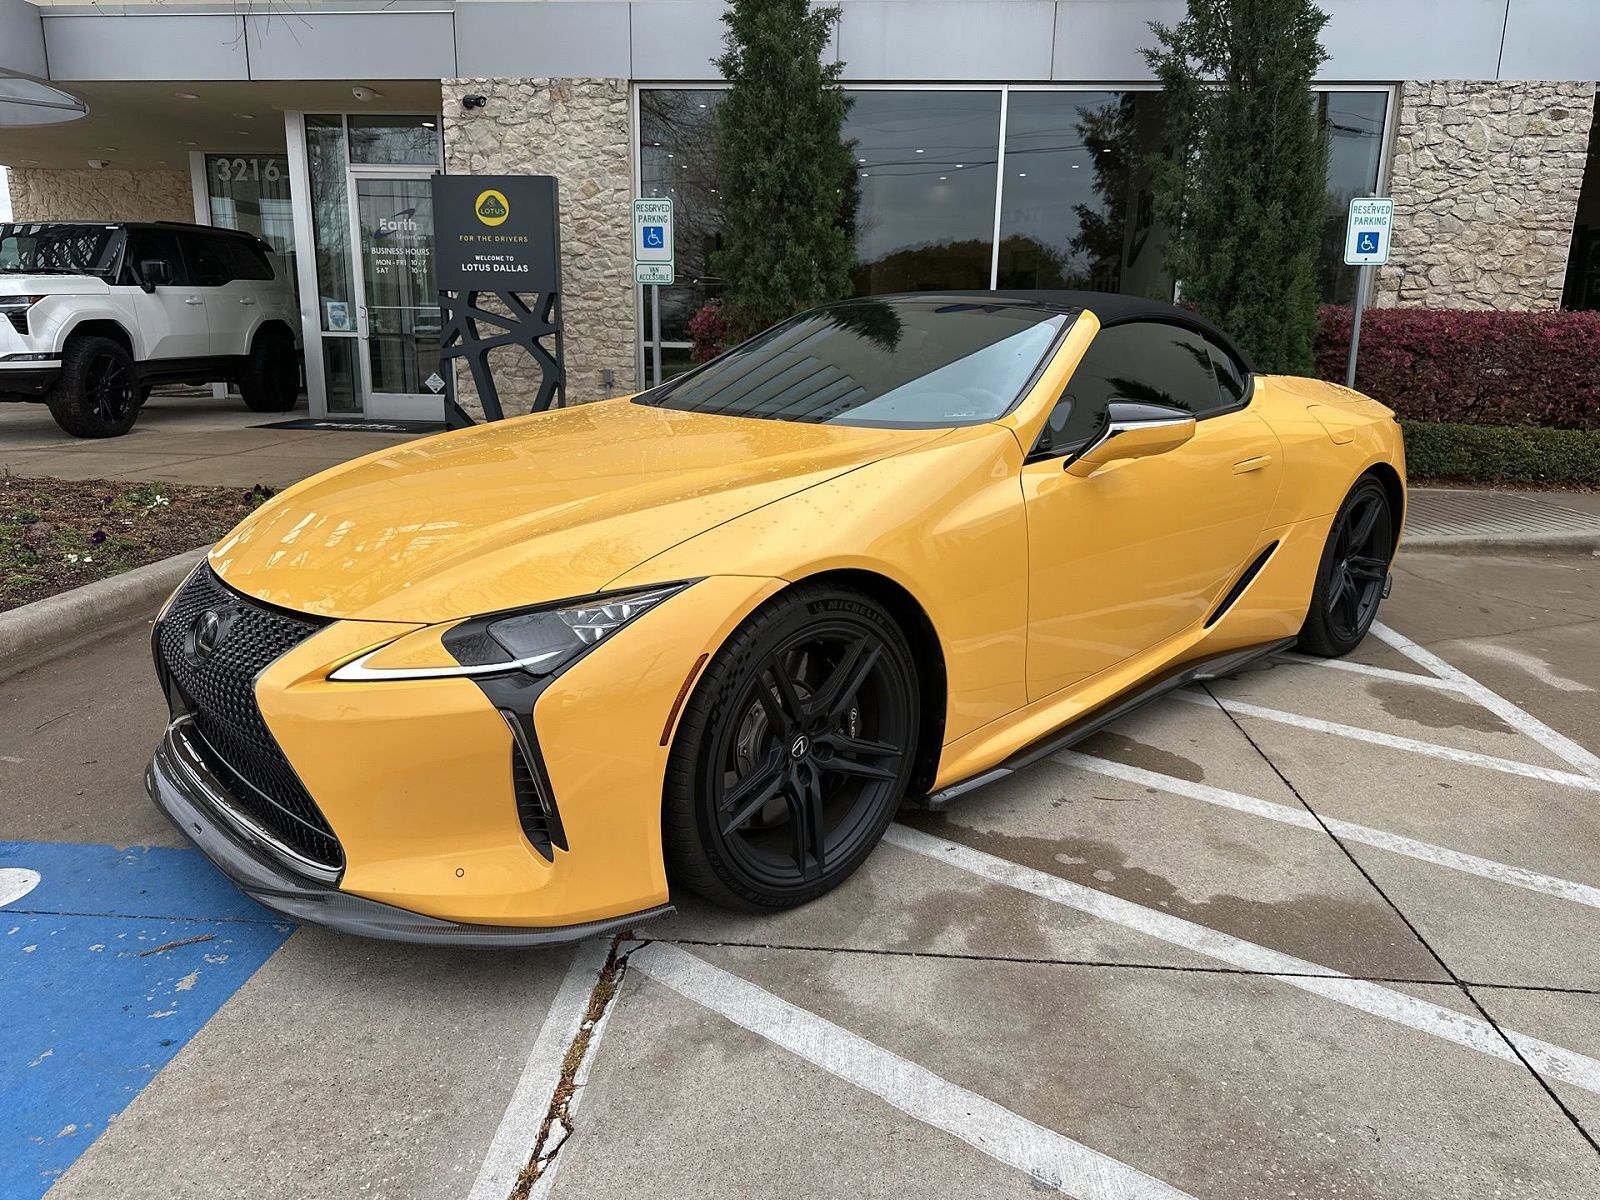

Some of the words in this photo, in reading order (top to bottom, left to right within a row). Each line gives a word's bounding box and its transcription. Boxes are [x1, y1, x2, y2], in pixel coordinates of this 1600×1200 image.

[216, 158, 280, 182] 3216
[636, 204, 670, 212] RESERVED
[1353, 205, 1391, 214] RESERVED
[638, 215, 668, 223] PARKING
[1353, 217, 1387, 225] PARKING
[379, 218, 417, 231] Earth
[461, 264, 491, 272] LOTUS
[493, 264, 529, 273] DALLAS
[827, 600, 884, 625] MICHELIN
